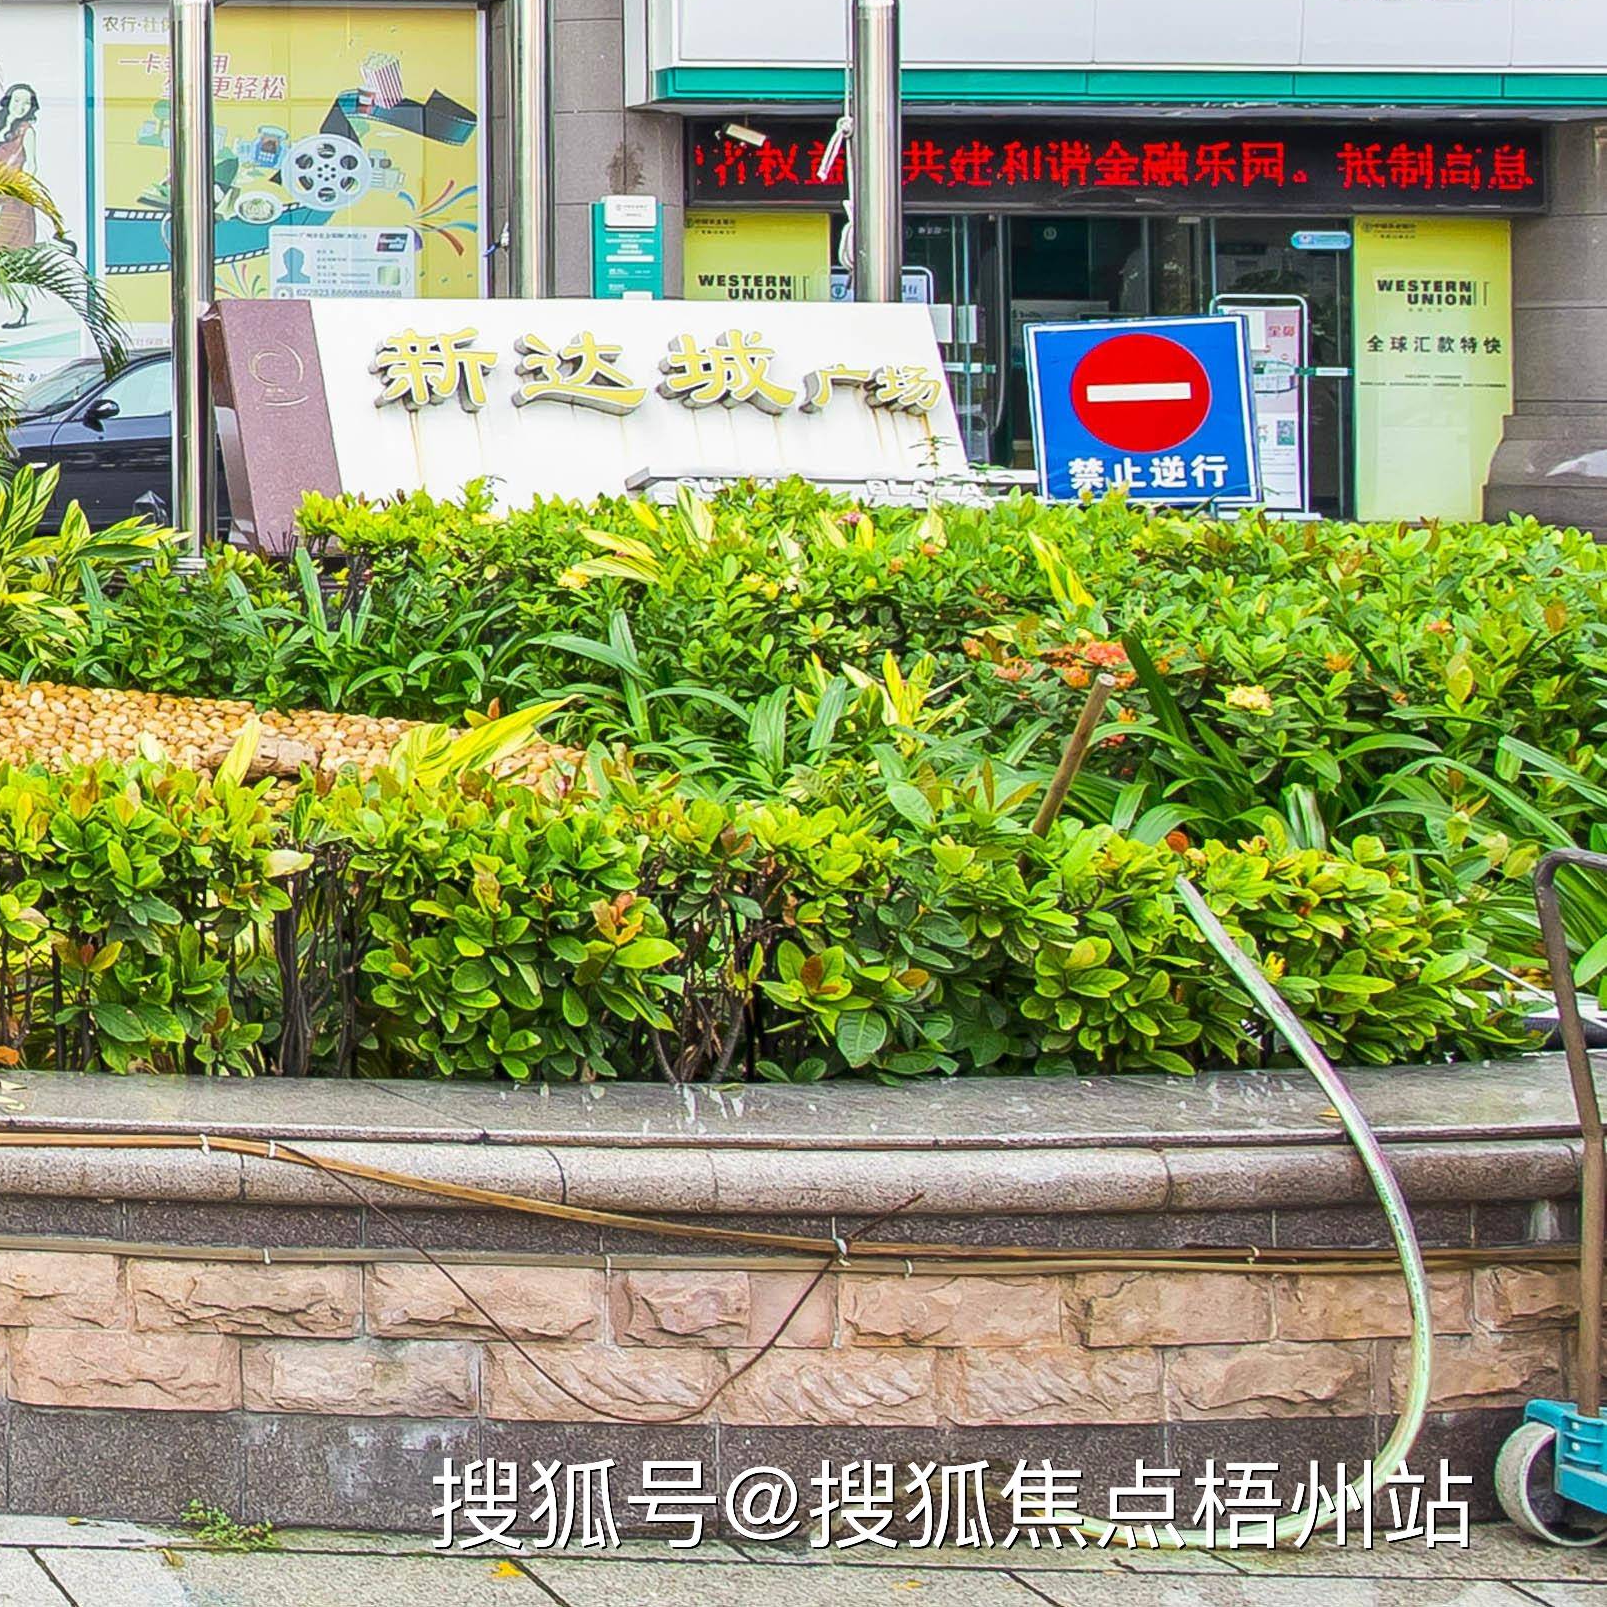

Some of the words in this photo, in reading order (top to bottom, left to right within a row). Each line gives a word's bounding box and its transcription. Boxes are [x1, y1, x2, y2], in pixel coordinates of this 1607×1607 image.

[698, 274, 792, 287] WESTERN
[1377, 279, 1473, 292] WESTERN
[728, 288, 792, 301] UNION
[1407, 293, 1473, 306] UNION
[1367, 334, 1502, 354] 全球汇款特快
[368, 327, 944, 416] 新达城广场
[1068, 454, 1229, 491] 禁止逆行
